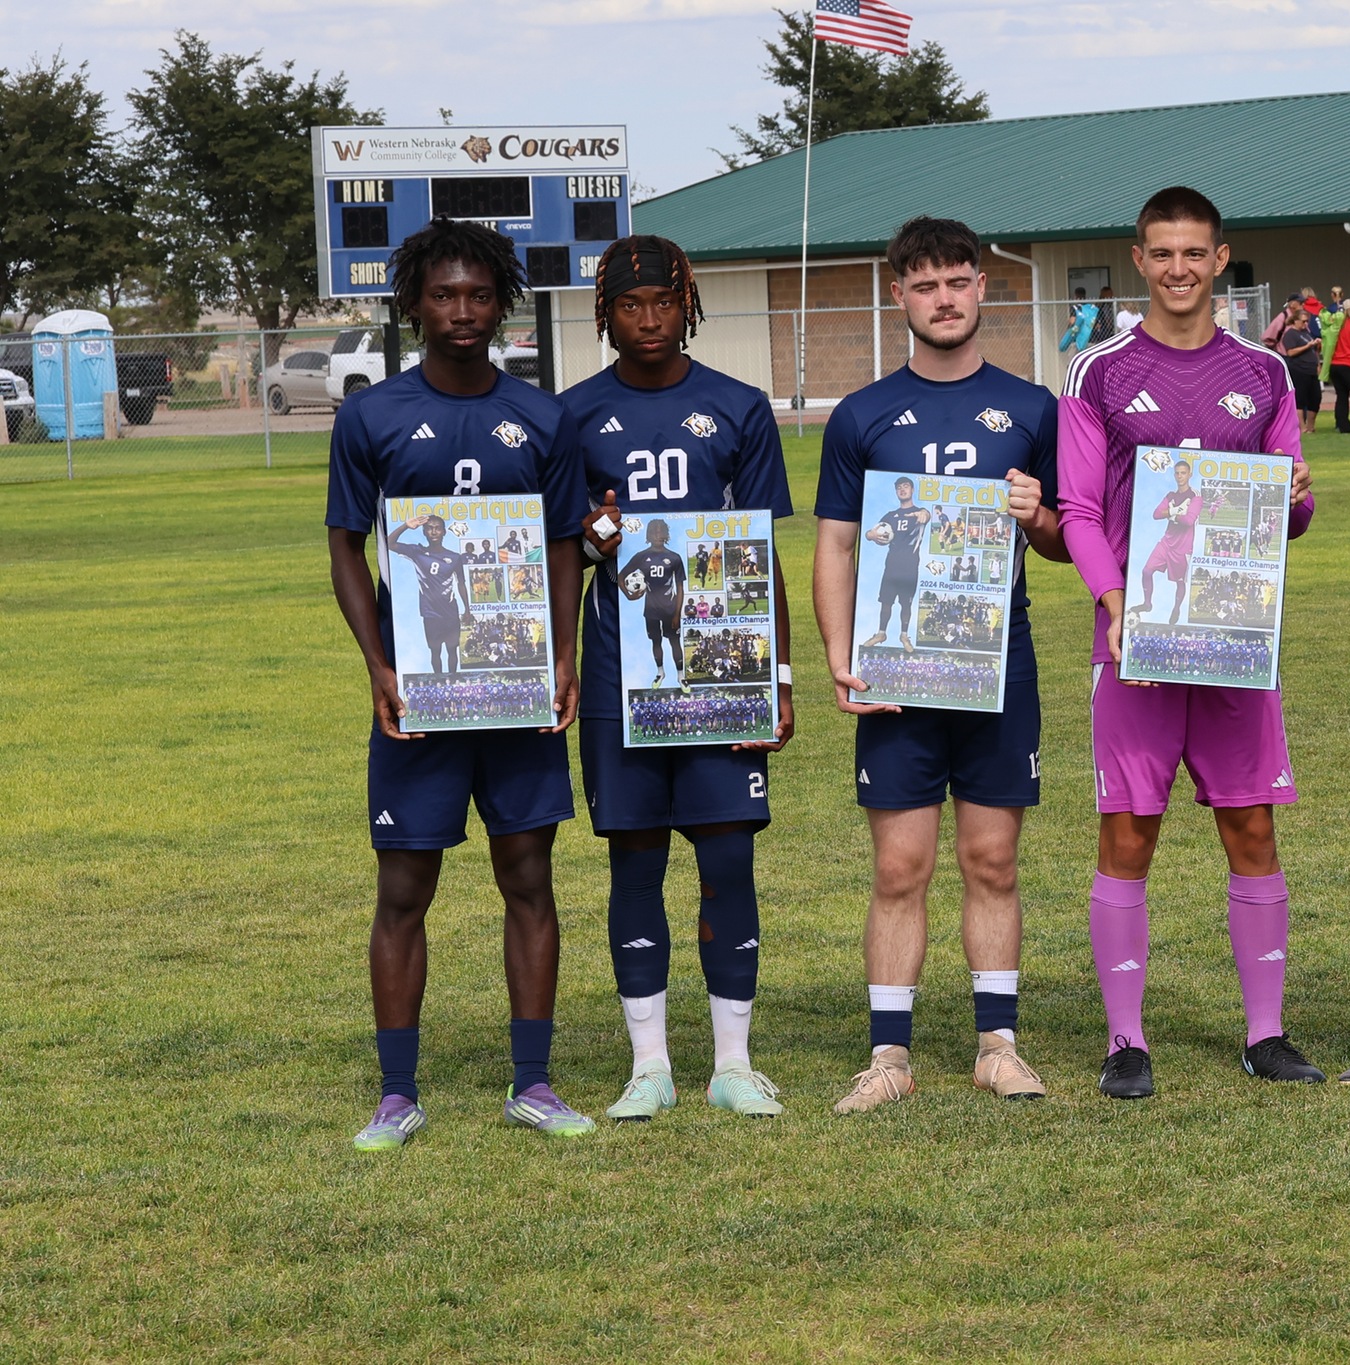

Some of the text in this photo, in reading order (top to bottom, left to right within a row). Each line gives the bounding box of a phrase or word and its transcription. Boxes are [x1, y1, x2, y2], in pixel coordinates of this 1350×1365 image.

[369, 137, 457, 150] Western Nebraska
[370, 150, 457, 162] Community College
[342, 180, 385, 203] HOME
[567, 176, 621, 198] GUESTS
[350, 262, 386, 285] SHOTS
[922, 441, 977, 475] 12
[1179, 451, 1289, 483] Tomas
[453, 458, 482, 495] 8
[626, 448, 688, 501] 20
[918, 479, 1009, 513] Brady
[390, 496, 542, 525] Mederique
[686, 514, 751, 539] Jeff
[897, 520, 908, 531] 12
[430, 562, 440, 575] 8
[649, 565, 664, 577] 20
[1211, 558, 1237, 566] Region
[1249, 561, 1279, 569] Champs
[920, 580, 937, 588] 2024
[939, 581, 965, 590] Region
[976, 584, 1006, 593] Champs
[486, 604, 510, 612] Region
[702, 617, 728, 625] Region
[739, 616, 769, 624] Champs
[748, 772, 767, 798] 2
